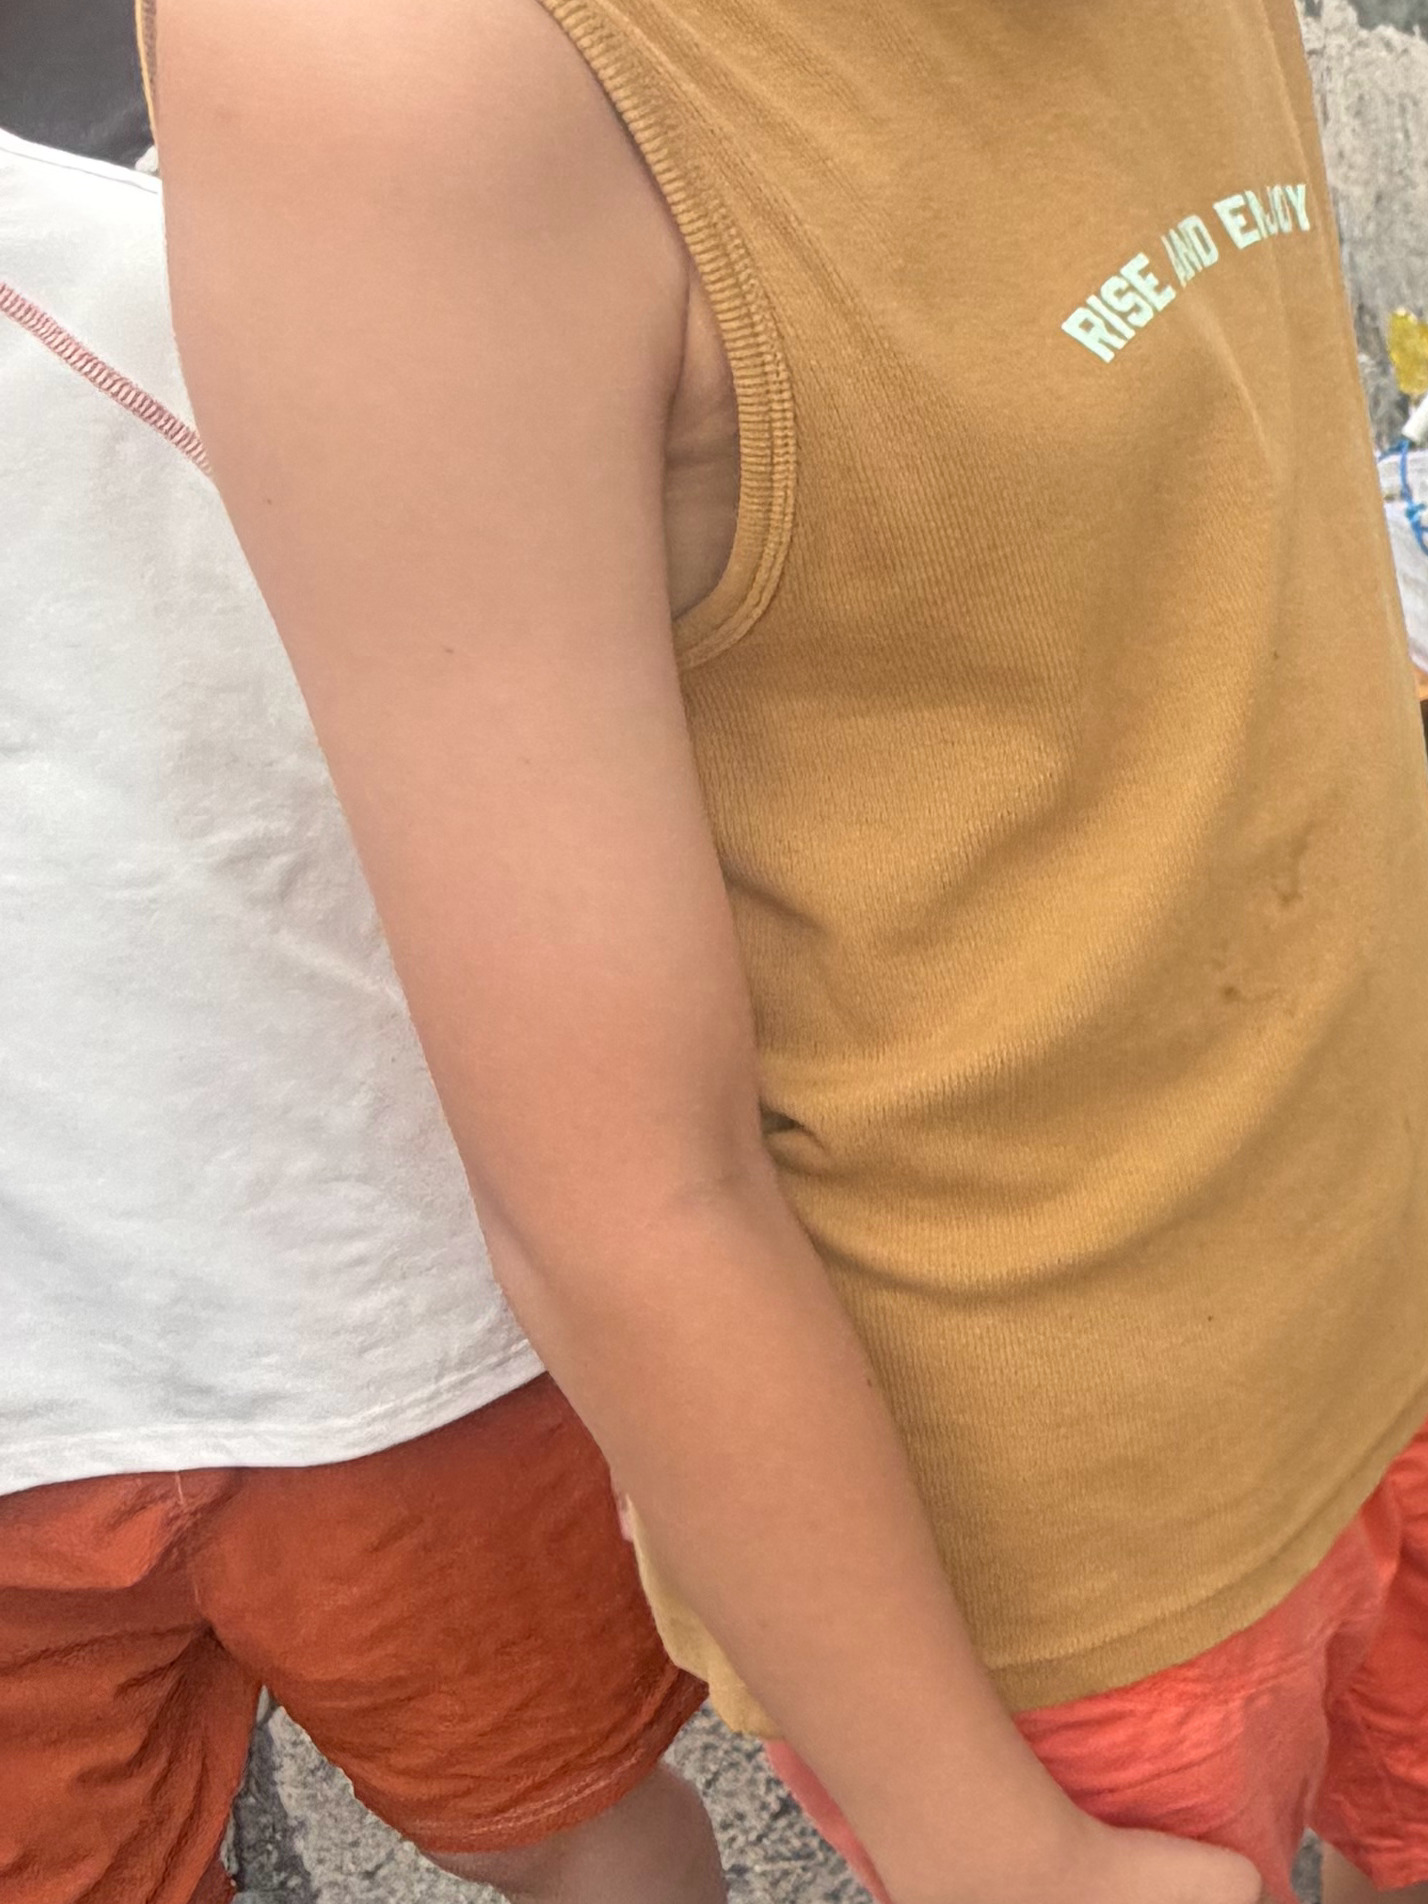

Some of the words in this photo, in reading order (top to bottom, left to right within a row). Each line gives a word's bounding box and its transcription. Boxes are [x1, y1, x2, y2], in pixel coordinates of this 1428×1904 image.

[1061, 252, 1176, 364] RISE
[1161, 214, 1219, 288] AND
[1213, 183, 1310, 249] ENJOY
